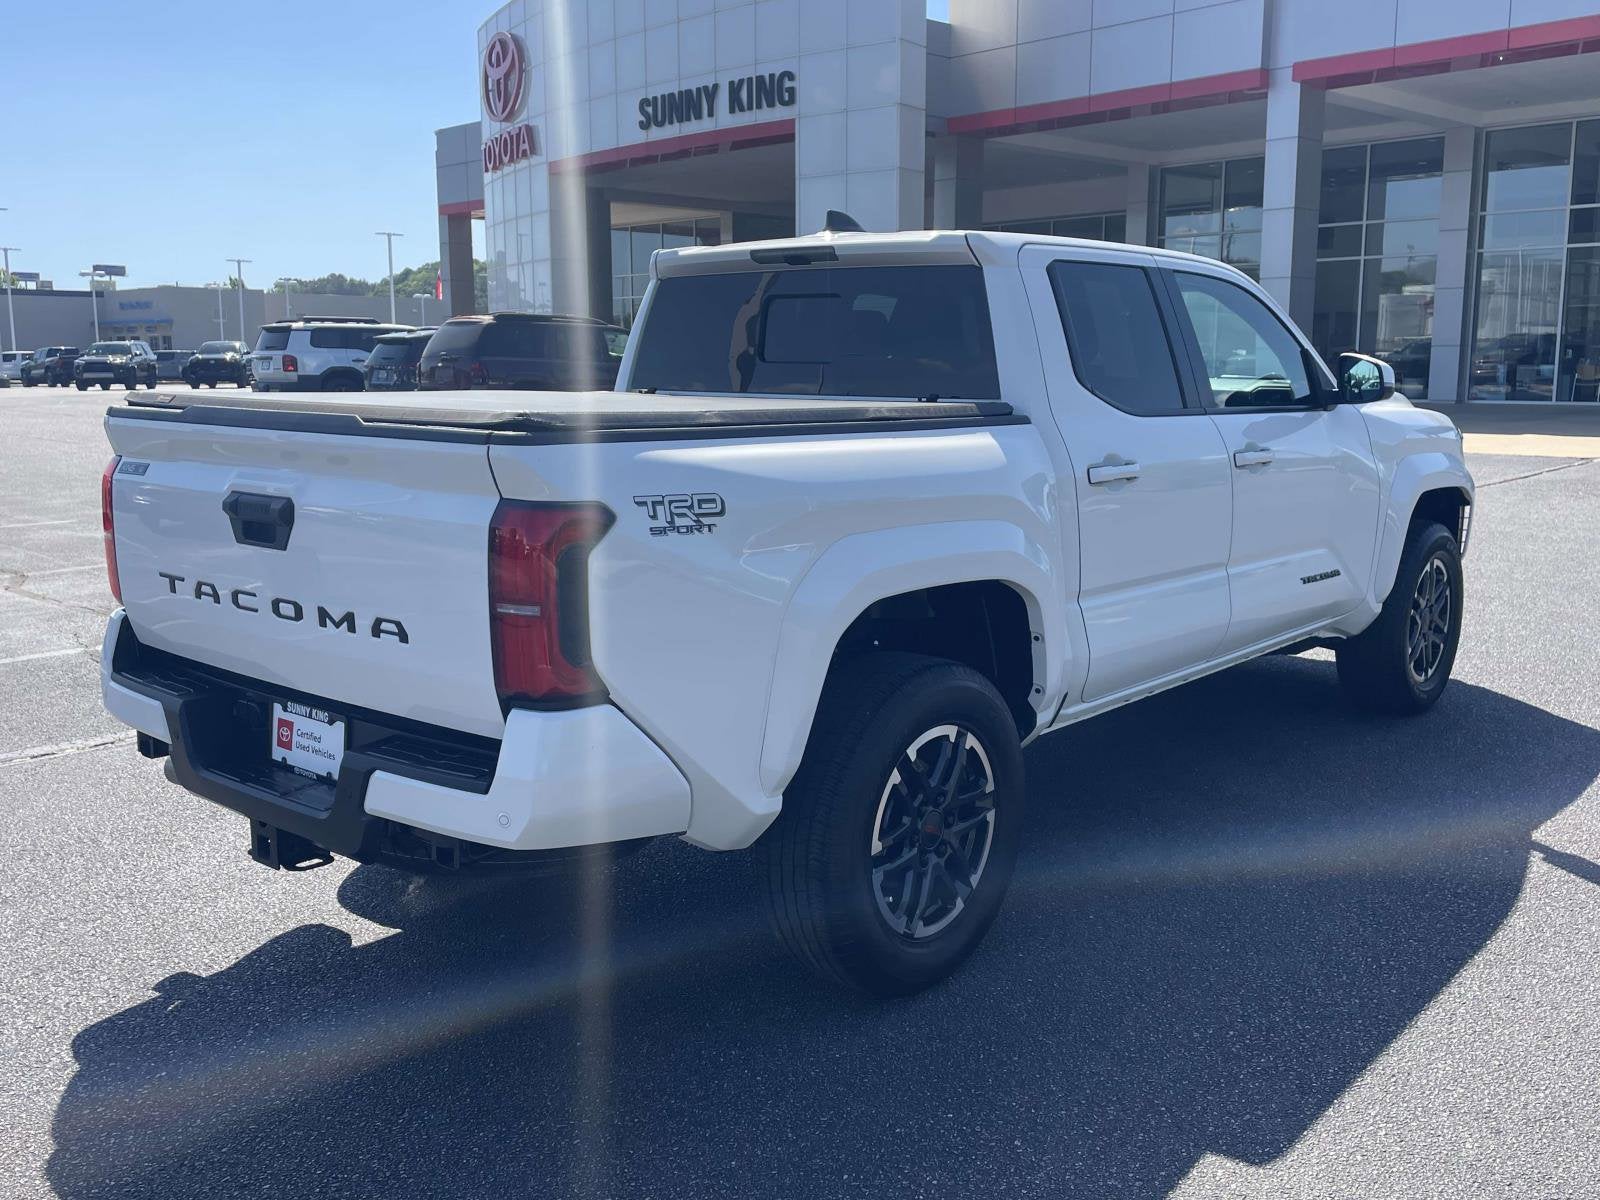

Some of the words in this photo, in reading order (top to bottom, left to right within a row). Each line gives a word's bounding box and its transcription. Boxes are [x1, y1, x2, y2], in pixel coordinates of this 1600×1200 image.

[638, 83, 719, 131] SUNNY
[728, 70, 796, 114] KING
[481, 124, 533, 173] TOYOTA
[633, 492, 726, 524] TRD
[649, 523, 717, 536] SPORT
[158, 571, 409, 644] TACOMA
[287, 701, 311, 718] SUNNY
[311, 708, 329, 723] KING
[296, 728, 321, 744] Certified
[295, 740, 310, 753] Used
[311, 748, 336, 761] Vehicles
